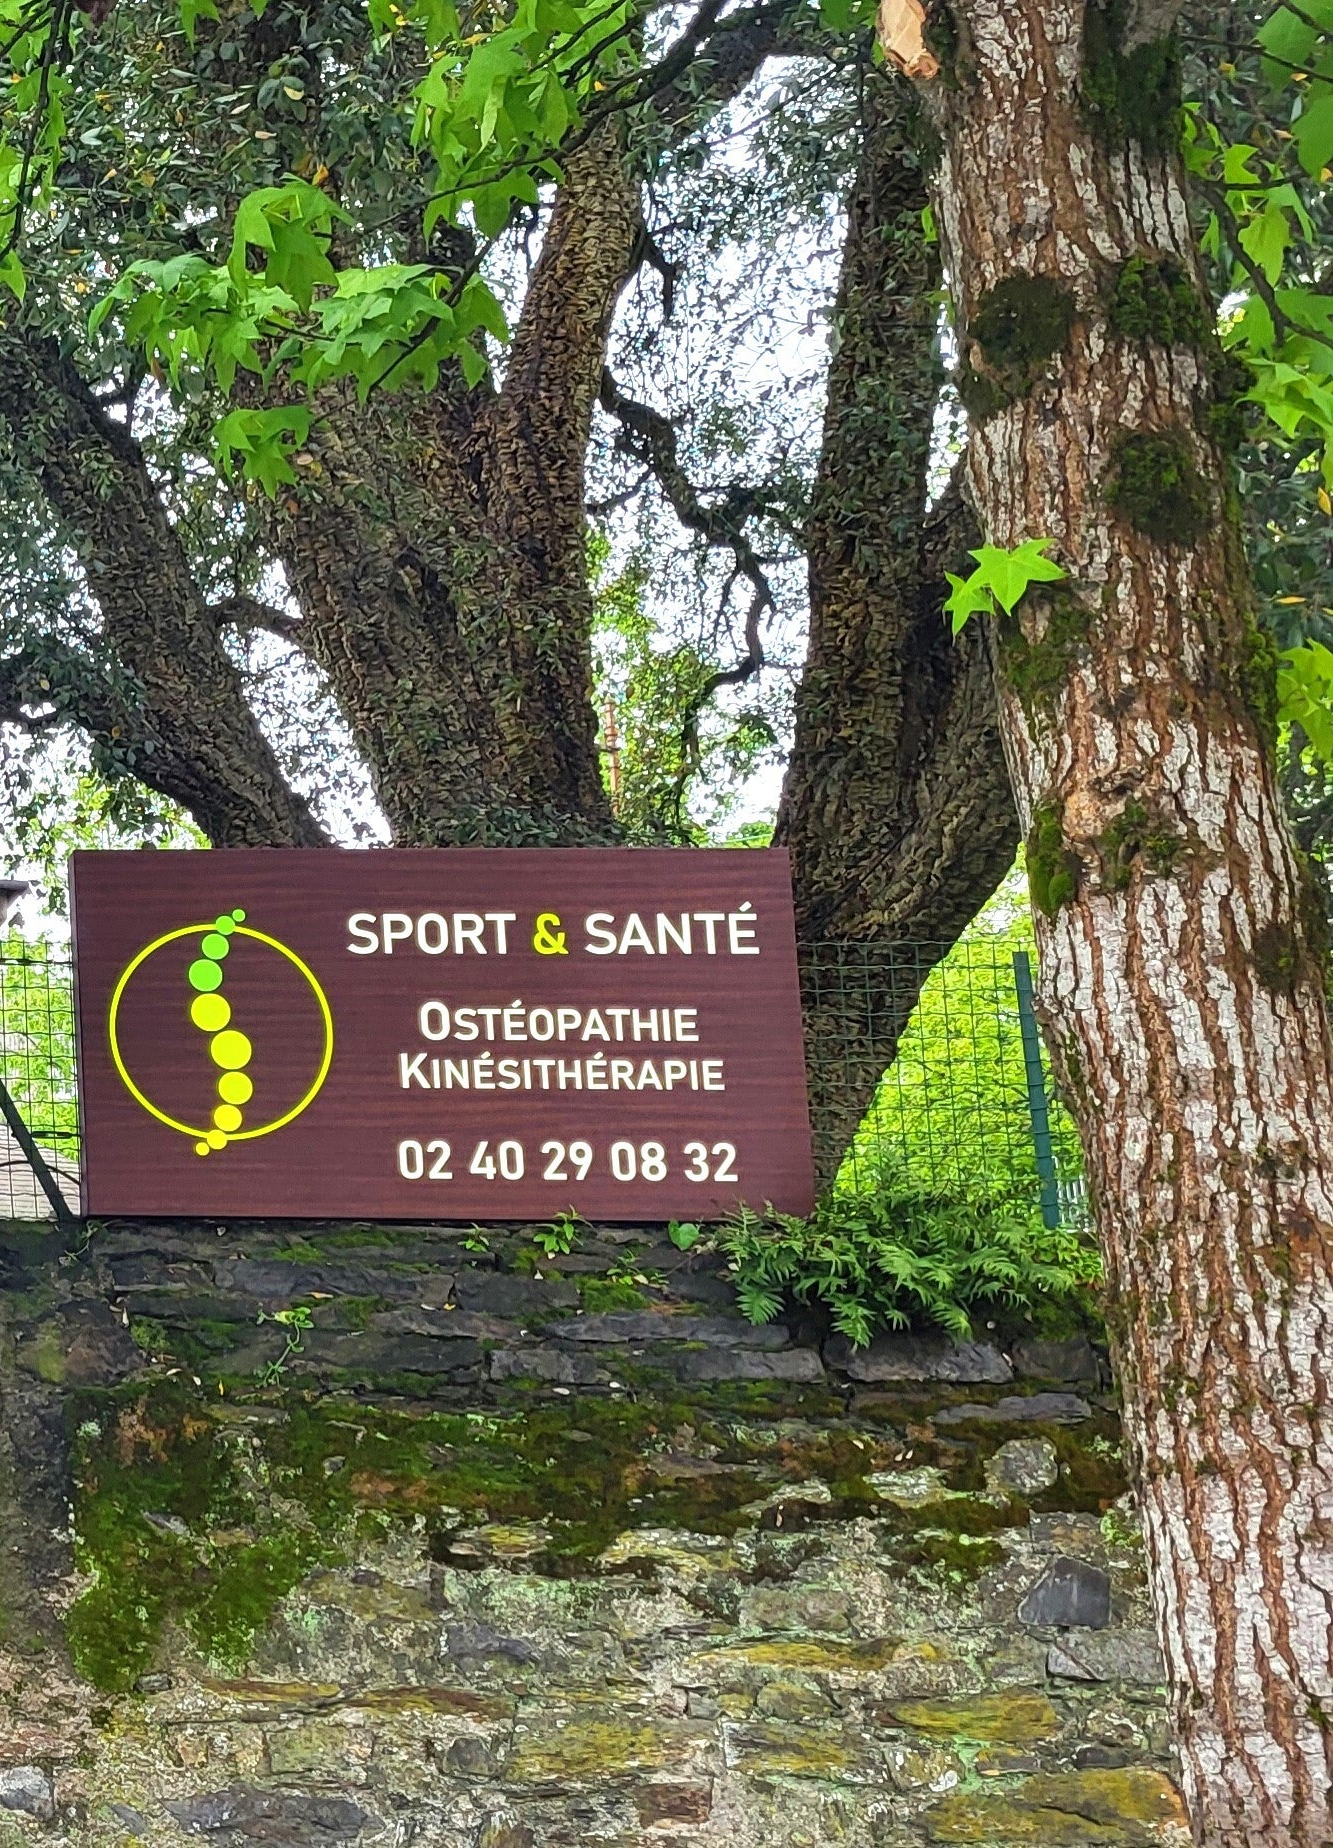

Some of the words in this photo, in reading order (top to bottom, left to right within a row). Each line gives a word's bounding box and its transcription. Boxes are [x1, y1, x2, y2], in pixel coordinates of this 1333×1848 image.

[346, 912, 516, 955] SPORT
[533, 912, 569, 955] &
[584, 901, 760, 955] SANTÉ
[419, 999, 699, 1042] OSTÉOPATHIE
[399, 1051, 726, 1091] KINÉSITHÉRAPIE
[397, 1139, 453, 1180] 02
[469, 1140, 525, 1180] 40
[540, 1141, 593, 1181] 29
[610, 1141, 667, 1182] 08
[683, 1142, 739, 1182] 32
